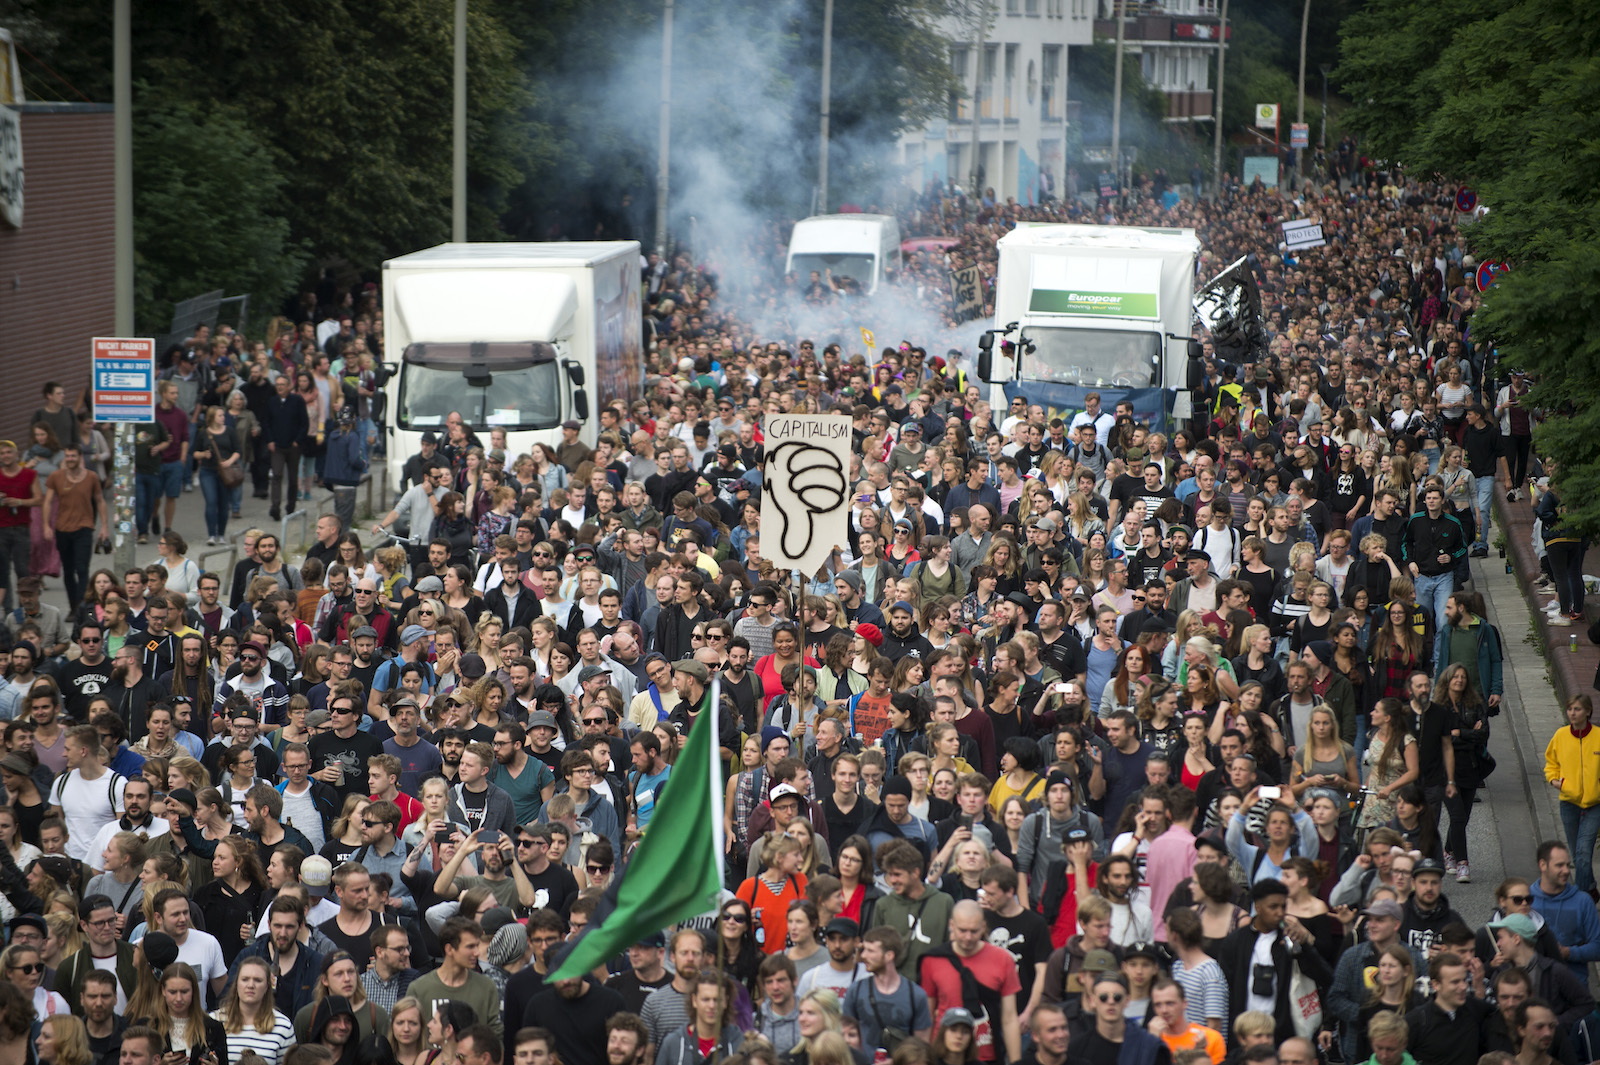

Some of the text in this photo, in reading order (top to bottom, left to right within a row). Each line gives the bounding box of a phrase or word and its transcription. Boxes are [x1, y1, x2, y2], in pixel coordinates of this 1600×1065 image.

[1287, 228, 1321, 240] PROTEST
[952, 271, 975, 292] YOU
[956, 286, 976, 304] ARE
[1068, 293, 1122, 304] Europcar
[98, 342, 148, 350] NICHT PARKEN
[769, 418, 848, 438] CAPITALISM
[74, 674, 109, 686] CROOKLYN
